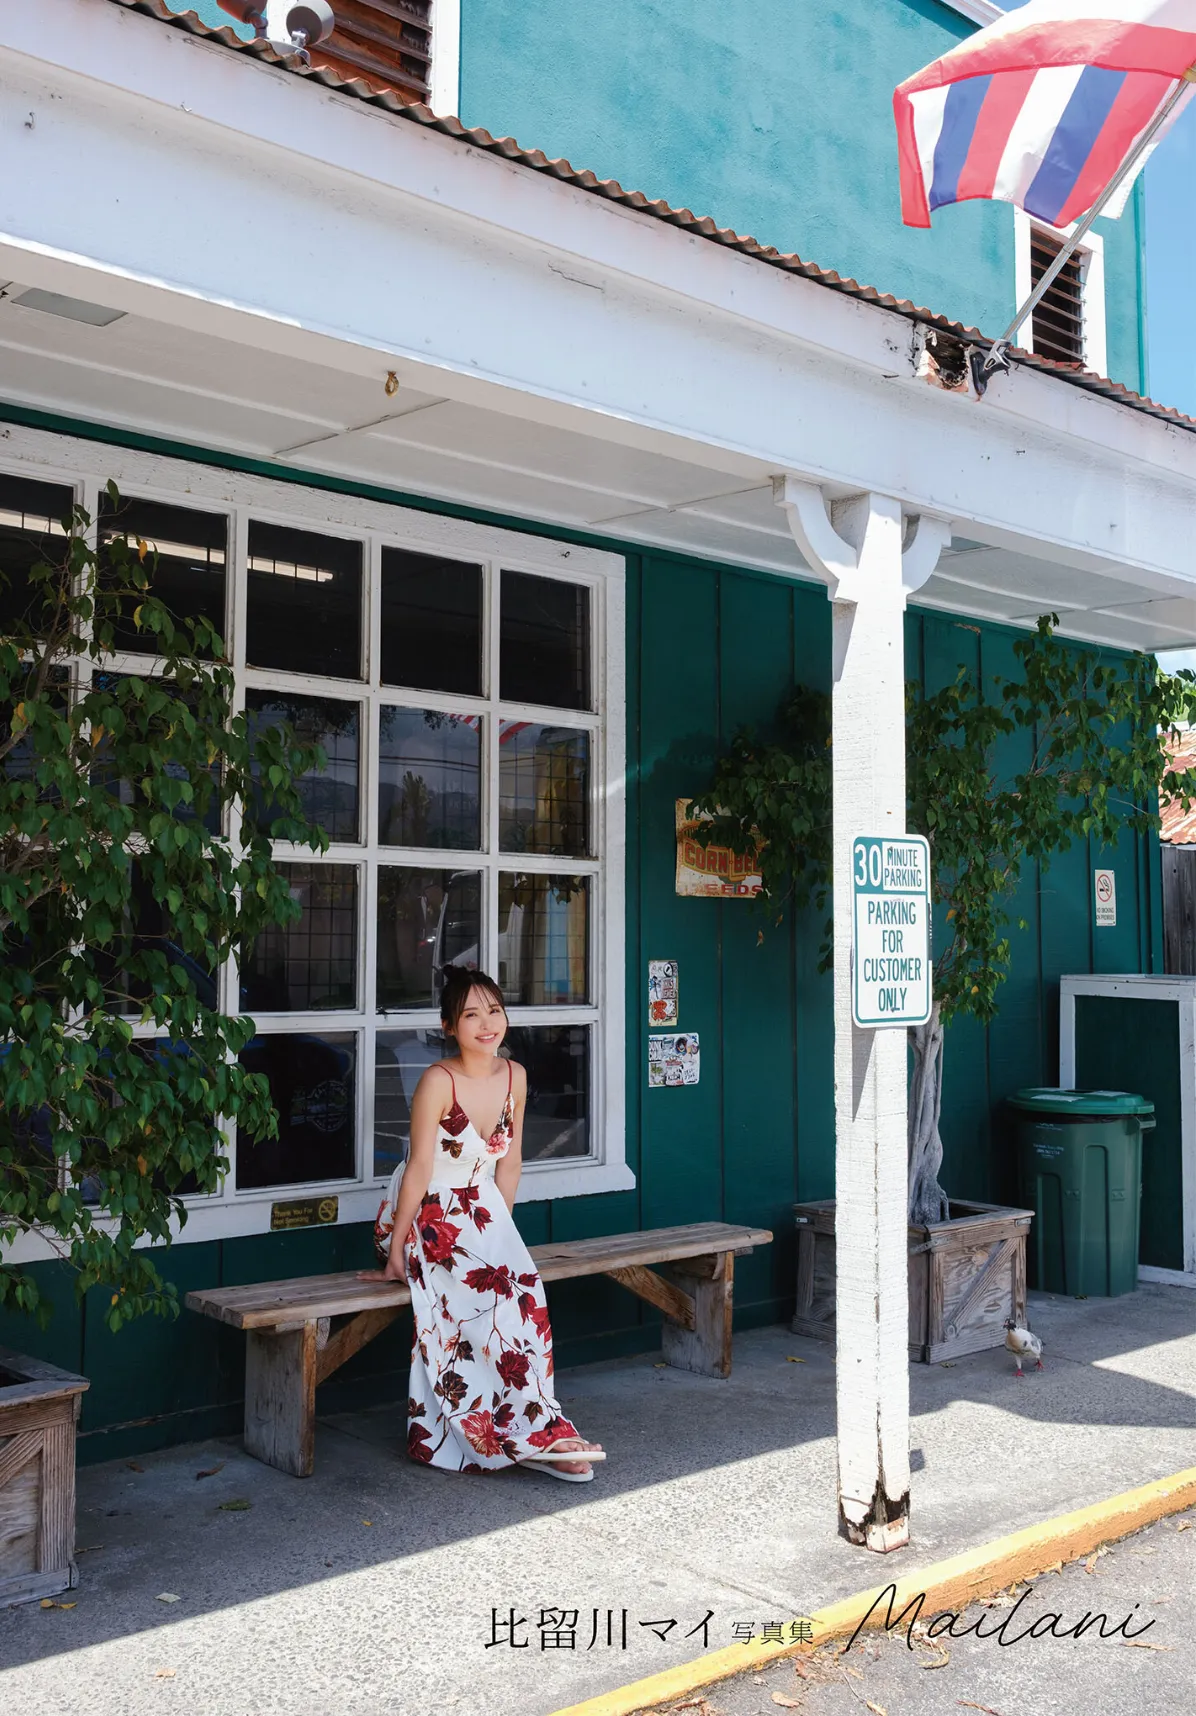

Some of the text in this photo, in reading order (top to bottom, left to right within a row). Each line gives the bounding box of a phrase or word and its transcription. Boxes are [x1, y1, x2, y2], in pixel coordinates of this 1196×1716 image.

[854, 843, 882, 887] 30
[887, 847, 919, 868] MINUTE
[884, 868, 922, 888] PARKING
[867, 901, 917, 925] PARKING
[882, 929, 904, 953] FOR
[863, 957, 922, 982] CUSTOMER
[878, 987, 908, 1012] ONLY
